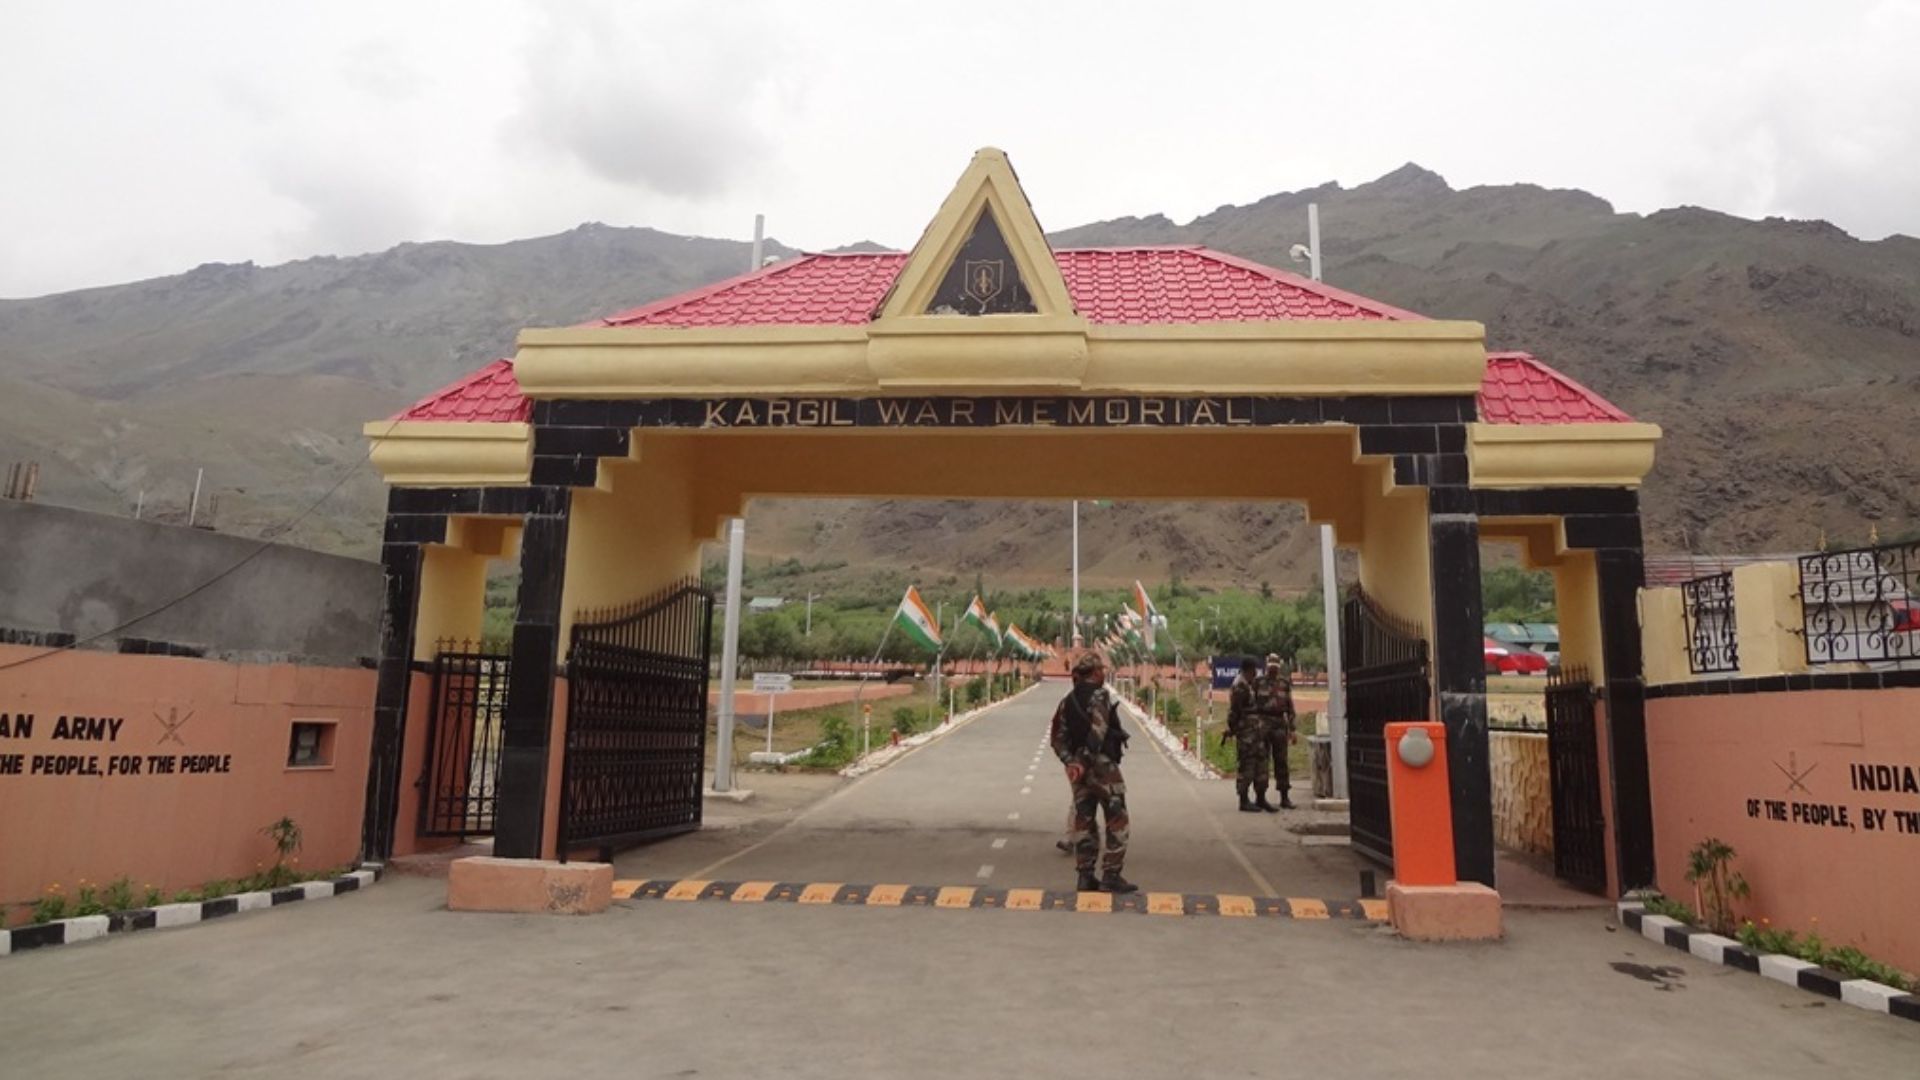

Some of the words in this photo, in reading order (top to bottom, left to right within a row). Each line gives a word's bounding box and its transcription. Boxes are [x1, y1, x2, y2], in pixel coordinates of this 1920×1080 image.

[704, 400, 854, 425] KARGIL
[877, 399, 974, 425] WAR
[995, 399, 1251, 425] MEMORIAL
[51, 715, 124, 742] ARMY
[0, 753, 25, 776] HE
[30, 755, 104, 778] PEOPLE,
[107, 755, 143, 776] FOR
[146, 755, 177, 775] THE
[179, 754, 232, 774] PEOPLE
[1850, 763, 1920, 794] INDIA
[1747, 798, 1761, 819] OF
[1764, 799, 1788, 822] THE
[1791, 802, 1857, 833] PEOPLE,
[1862, 807, 1887, 831] BY
[1892, 810, 1920, 835] TH
